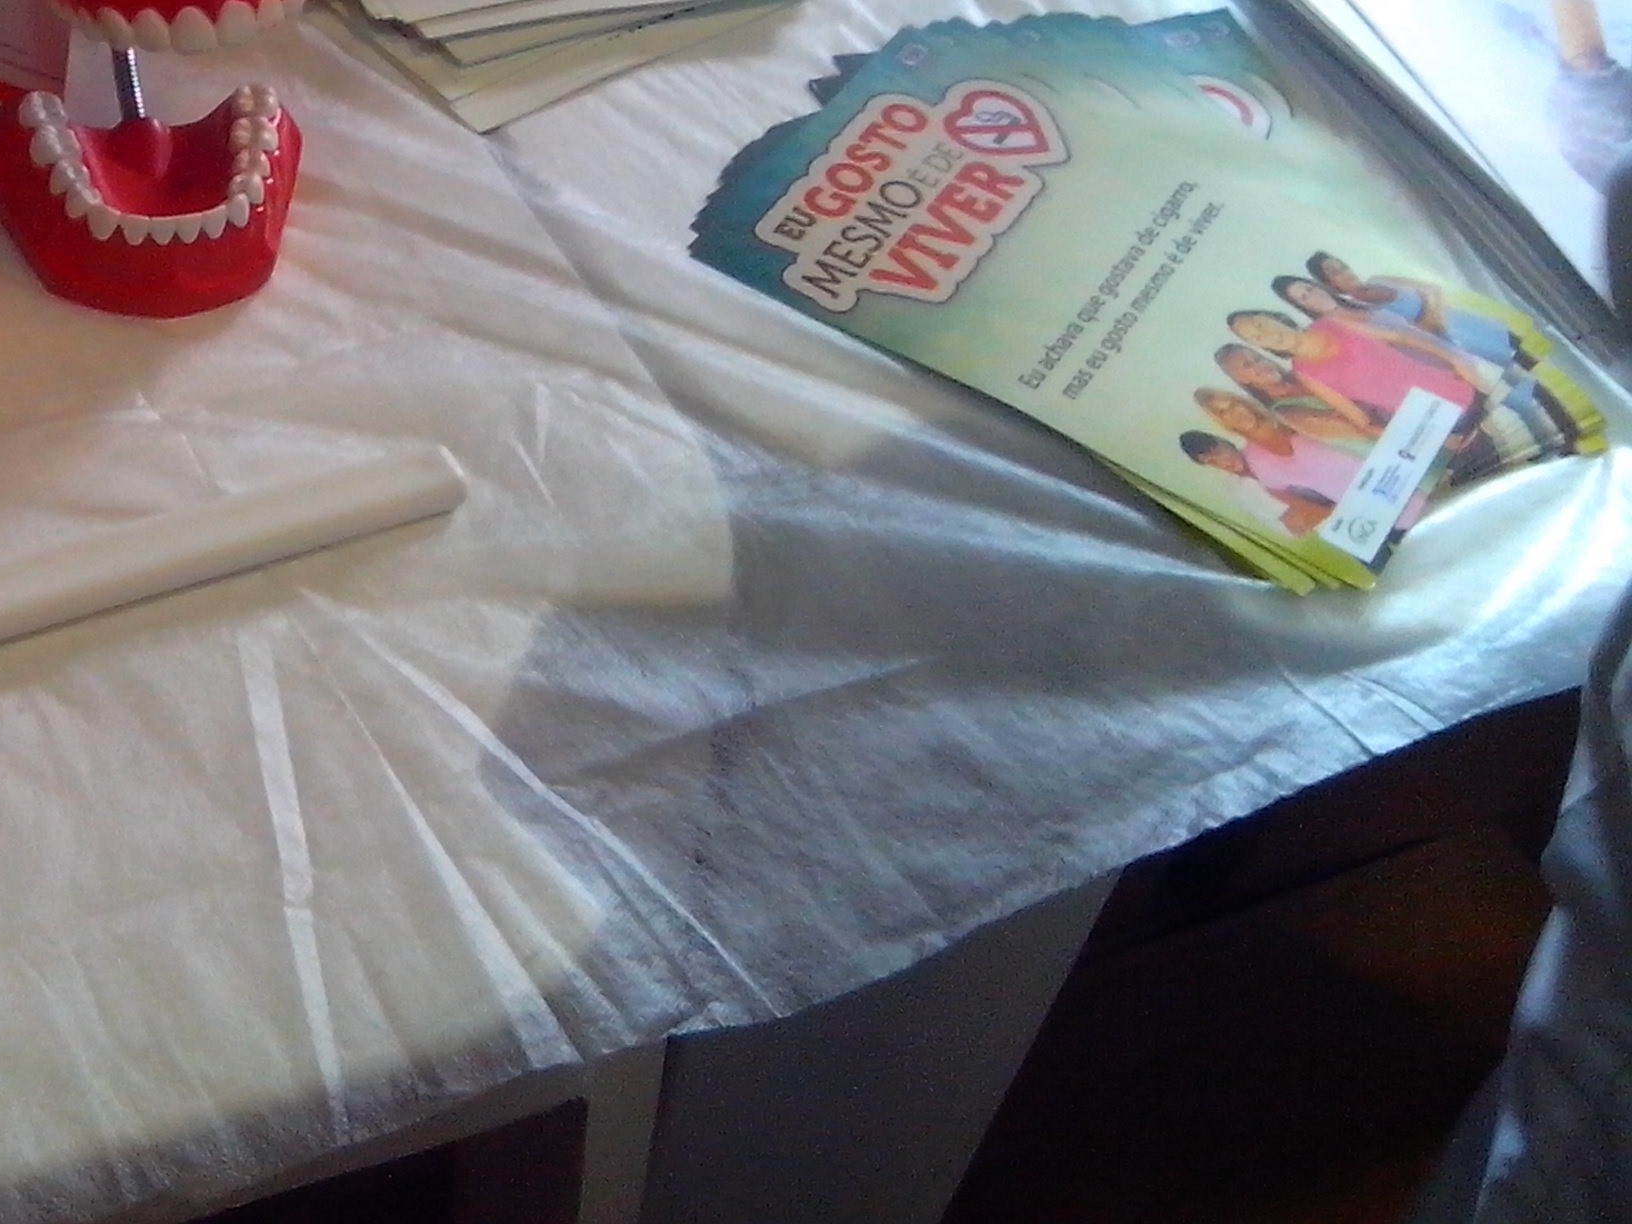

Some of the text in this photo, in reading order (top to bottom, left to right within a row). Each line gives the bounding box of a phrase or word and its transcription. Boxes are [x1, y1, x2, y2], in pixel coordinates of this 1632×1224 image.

[772, 102, 927, 241] EU GOSTO
[800, 179, 922, 298] MESMO
[921, 142, 965, 173] DE
[868, 160, 1025, 292] VIVER
[1017, 368, 1047, 390] Eu
[1037, 322, 1085, 372] achava
[1077, 295, 1107, 323] que
[1098, 245, 1147, 300] gostava
[1136, 226, 1161, 247] de
[1061, 368, 1095, 400] mas
[1085, 349, 1109, 371] eu
[1100, 311, 1139, 354] gosto
[1130, 262, 1176, 314] mesmo
[1172, 235, 1198, 255] de
